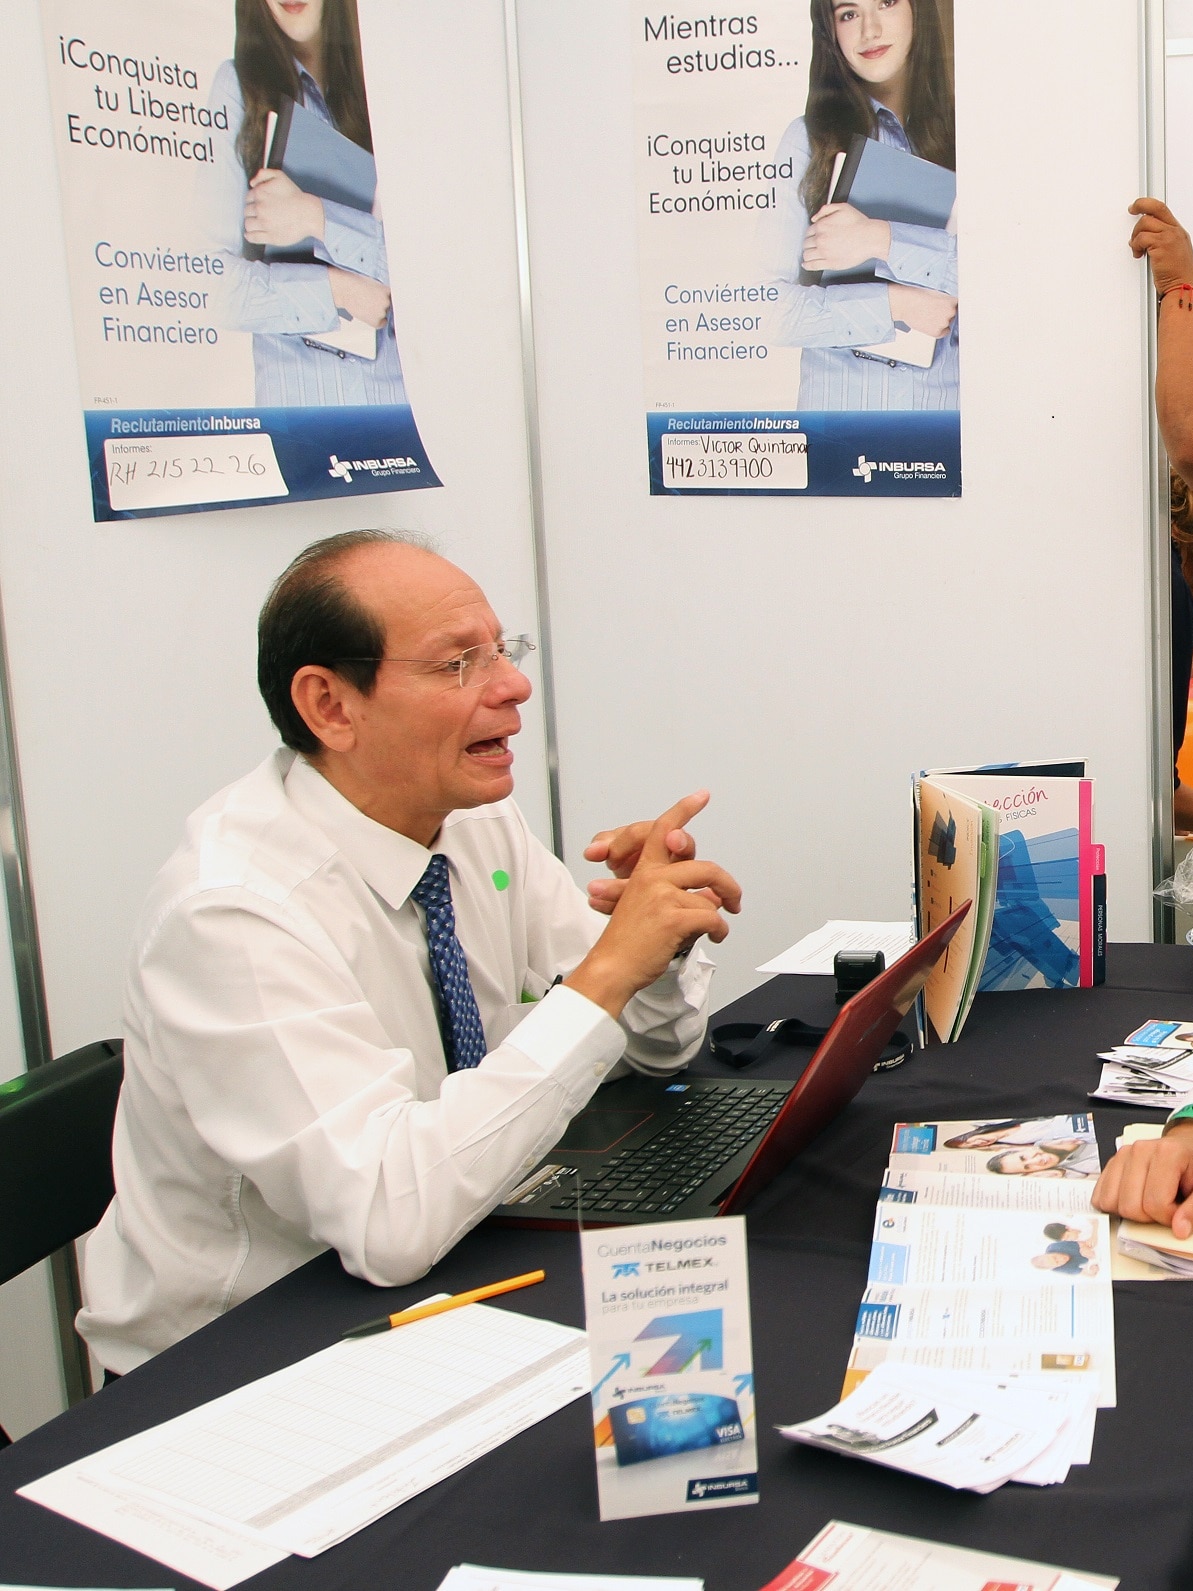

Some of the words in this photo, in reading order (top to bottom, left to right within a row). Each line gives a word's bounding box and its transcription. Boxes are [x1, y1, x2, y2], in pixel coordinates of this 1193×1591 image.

[644, 13, 758, 42] Mientras
[666, 45, 799, 74] estudias...
[95, 84, 119, 112] tu
[128, 88, 229, 131] Libertad
[67, 116, 215, 164] Económica!
[673, 163, 692, 184] tu
[700, 157, 794, 182] Libertad
[649, 188, 777, 214] Económica!
[95, 241, 224, 275] Conviértete
[99, 285, 128, 305] en
[137, 285, 209, 309] Asesor
[665, 283, 779, 304] Conviértete
[103, 317, 219, 345] Financiero
[665, 317, 689, 332] en
[695, 314, 762, 332] Asesor
[666, 342, 768, 361] Financiero
[112, 444, 153, 454] Informes:
[668, 438, 700, 446] Informes:
[352, 457, 417, 471] INBURSA
[371, 469, 391, 477] Grupo
[392, 467, 420, 475] Financiero
[879, 462, 946, 472] INBURSA
[894, 472, 913, 480] Grupo
[597, 1236, 727, 1258] CuentaNegocios
[645, 1257, 713, 1273] TELMEX
[601, 1291, 616, 1303] La
[620, 1285, 674, 1302] solución
[679, 1279, 728, 1295] integral
[716, 1423, 740, 1438] VISA
